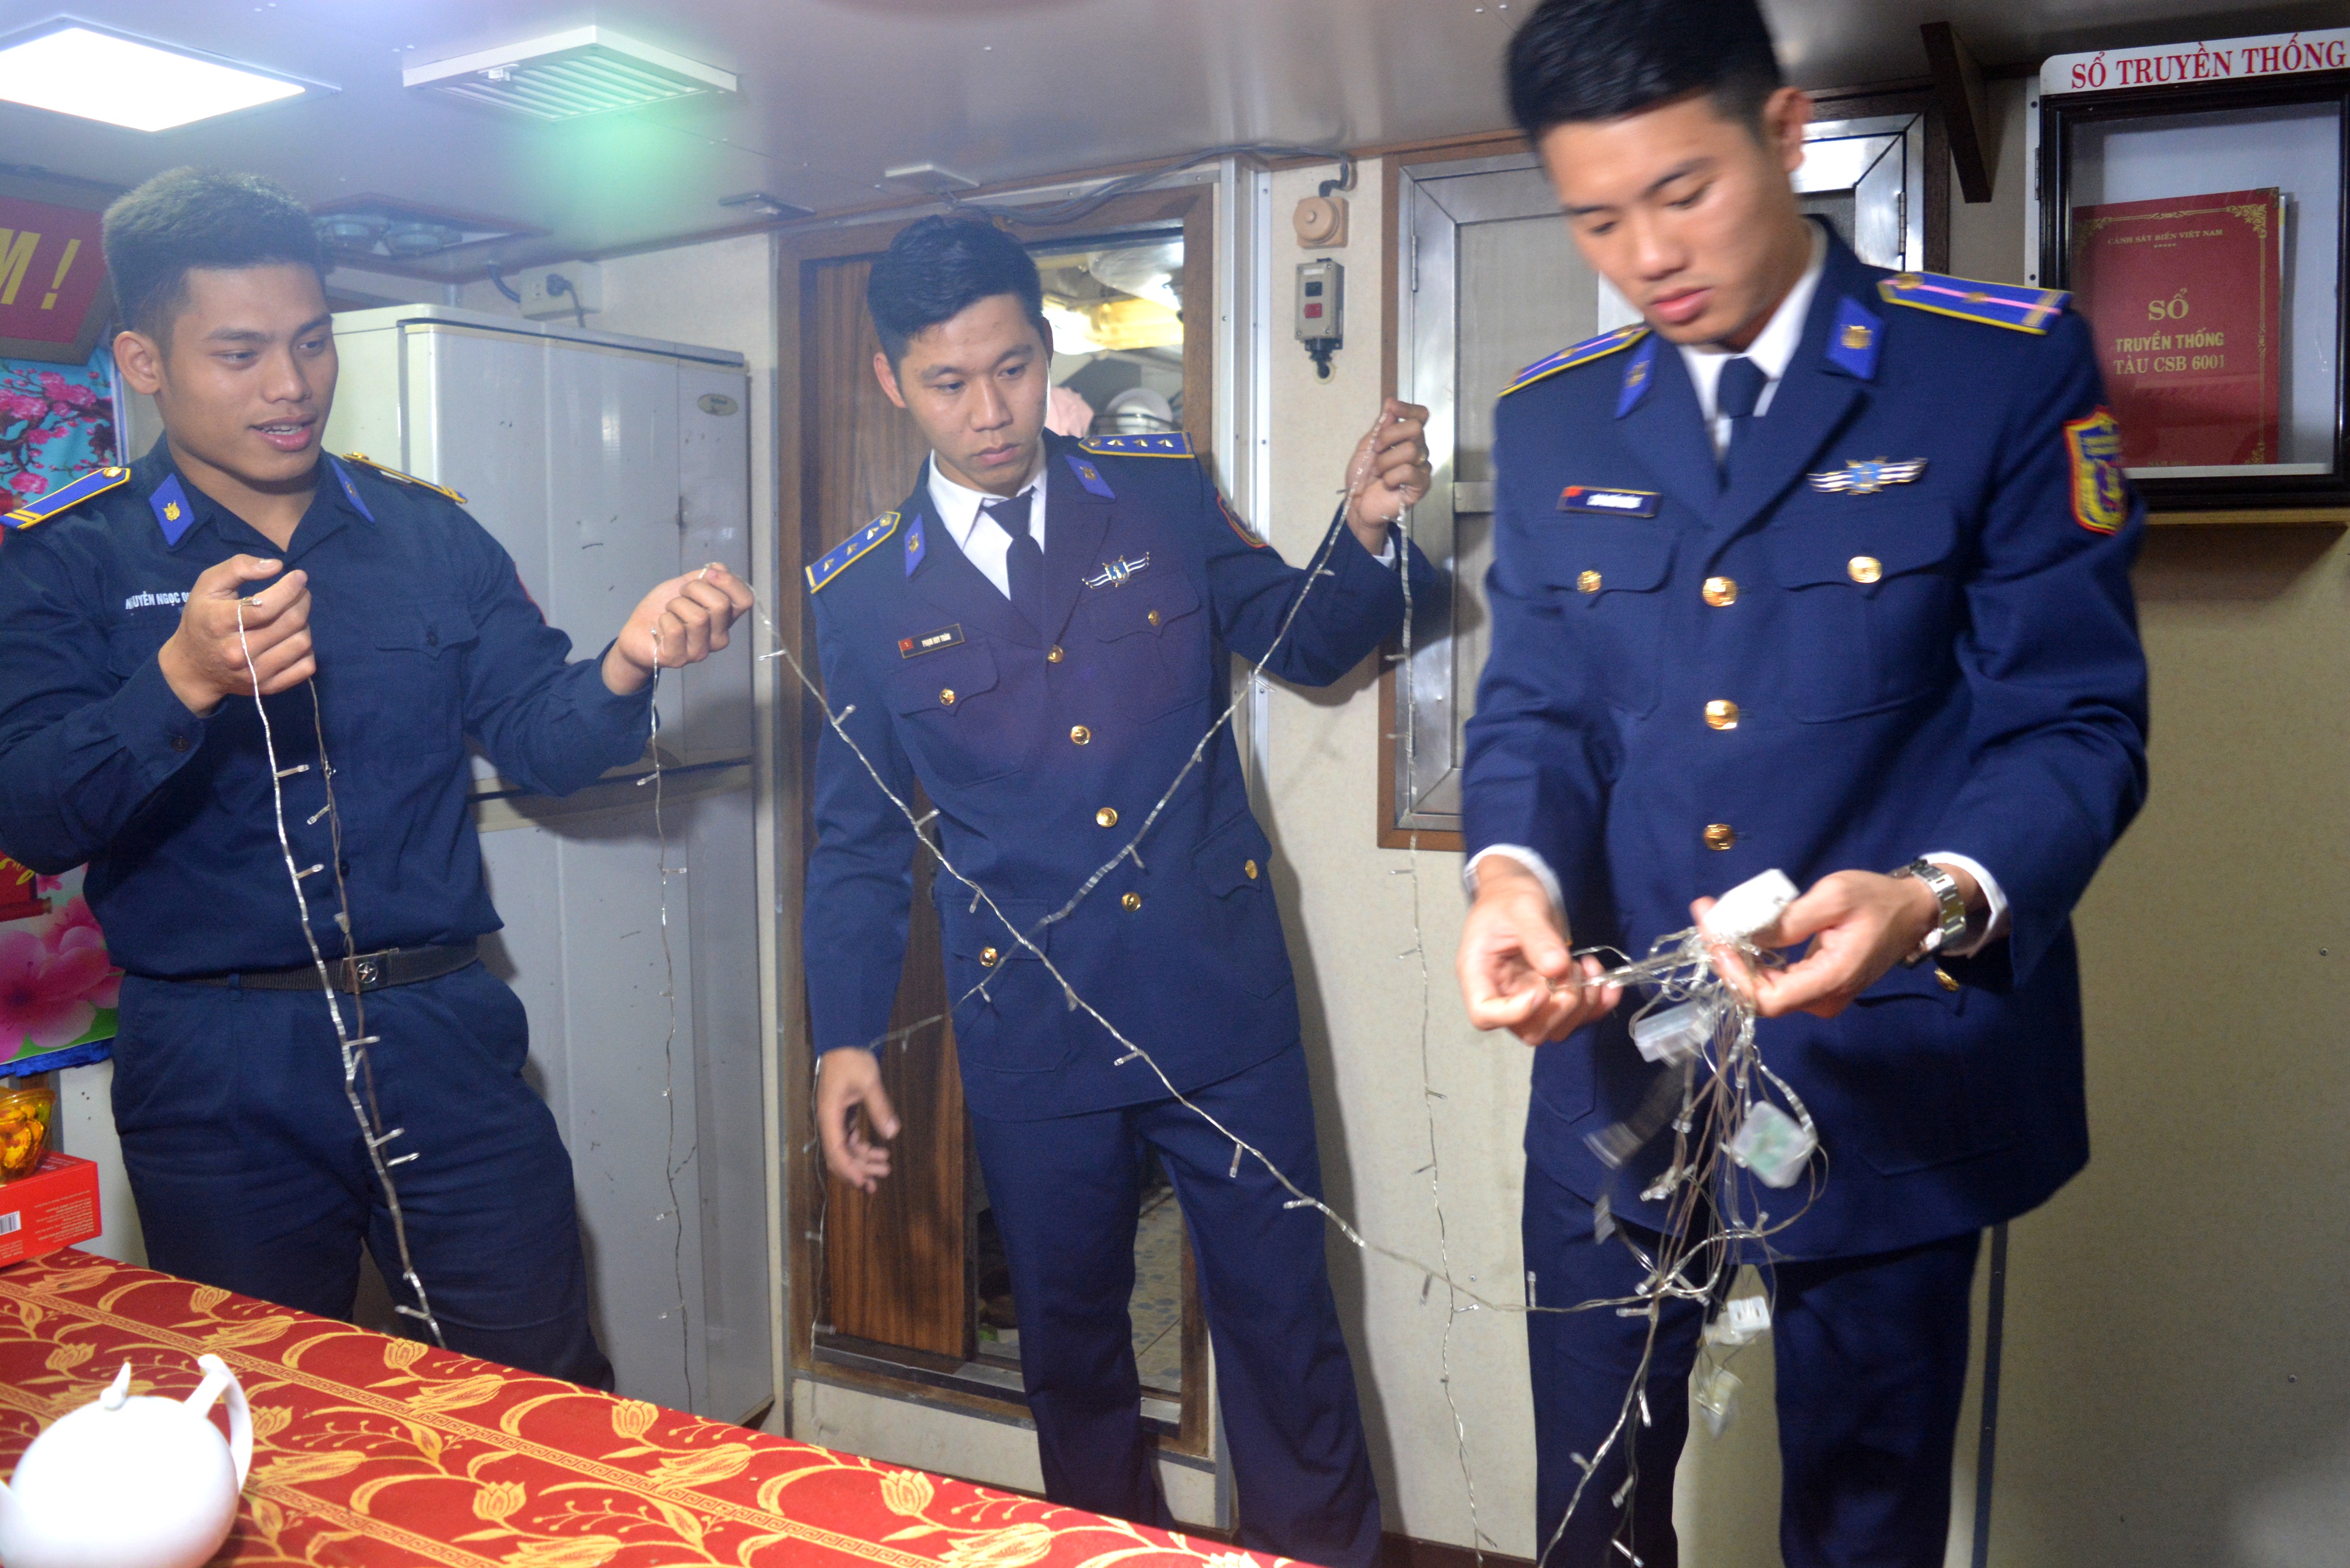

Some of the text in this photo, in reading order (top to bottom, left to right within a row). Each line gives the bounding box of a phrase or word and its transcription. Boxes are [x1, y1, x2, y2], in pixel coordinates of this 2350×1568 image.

[2071, 33, 2347, 89] SỔ TRUYỀN THỐNG
[2148, 288, 2189, 320] SỔ
[2115, 328, 2224, 352] TRUYỀN THỐNG
[2113, 355, 2225, 375] TÀU CSB 6001
[156, 592, 181, 606] NGỌC
